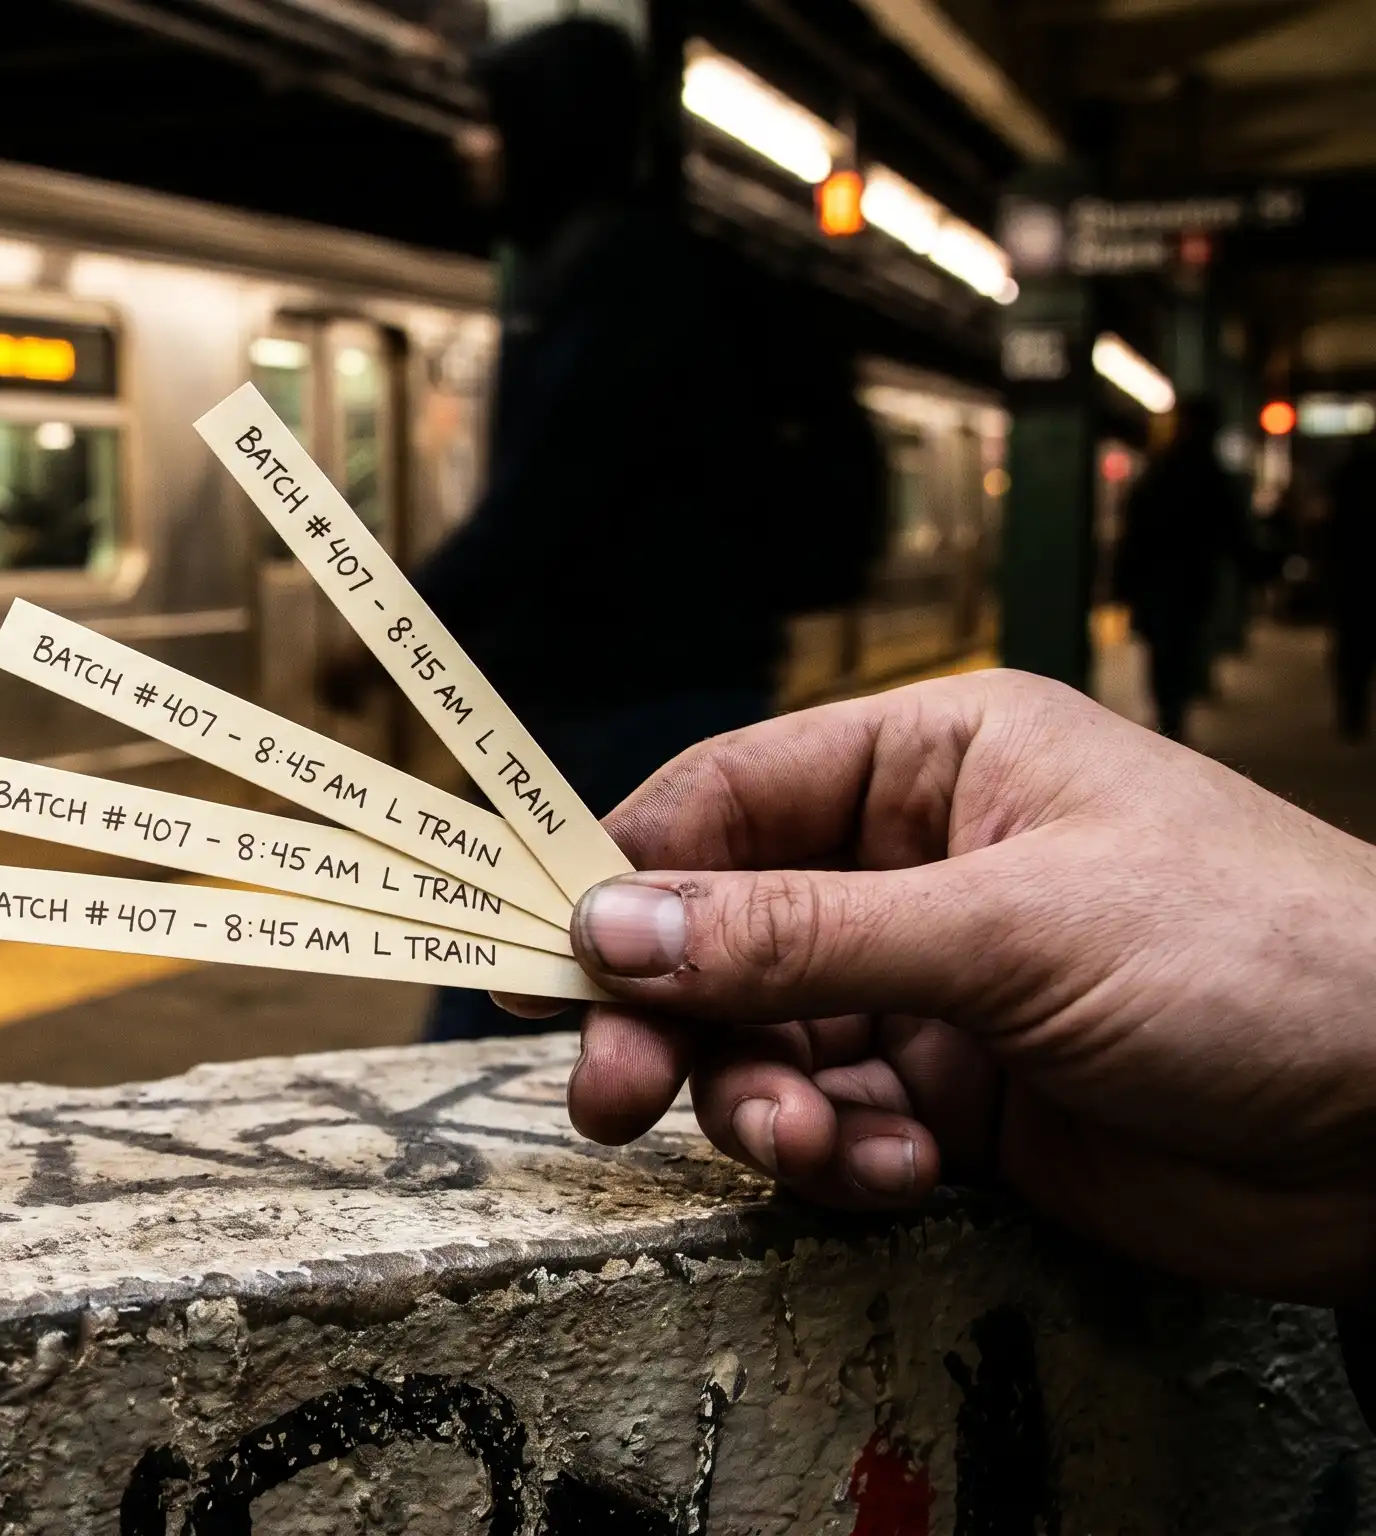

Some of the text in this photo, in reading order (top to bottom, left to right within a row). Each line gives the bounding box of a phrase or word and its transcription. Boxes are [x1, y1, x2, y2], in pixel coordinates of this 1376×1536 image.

[234, 425, 310, 514] BATCH
[387, 616, 447, 681] 8:45
[433, 684, 474, 726] AM
[475, 729, 495, 755] L
[497, 751, 567, 836] TRAIN
[32, 634, 124, 696] BATCH
[254, 736, 326, 784] 8:45
[322, 774, 368, 809] AM
[385, 797, 402, 824] L
[417, 810, 502, 868] TRAIN
[224, 914, 299, 947] 8:45
[304, 927, 350, 954] AM
[374, 931, 392, 956] L
[404, 936, 496, 967] TRAIN
[237, 833, 311, 871] 8:45
[314, 854, 359, 884] AM
[382, 866, 400, 892] L
[413, 873, 502, 915] TRAIN
